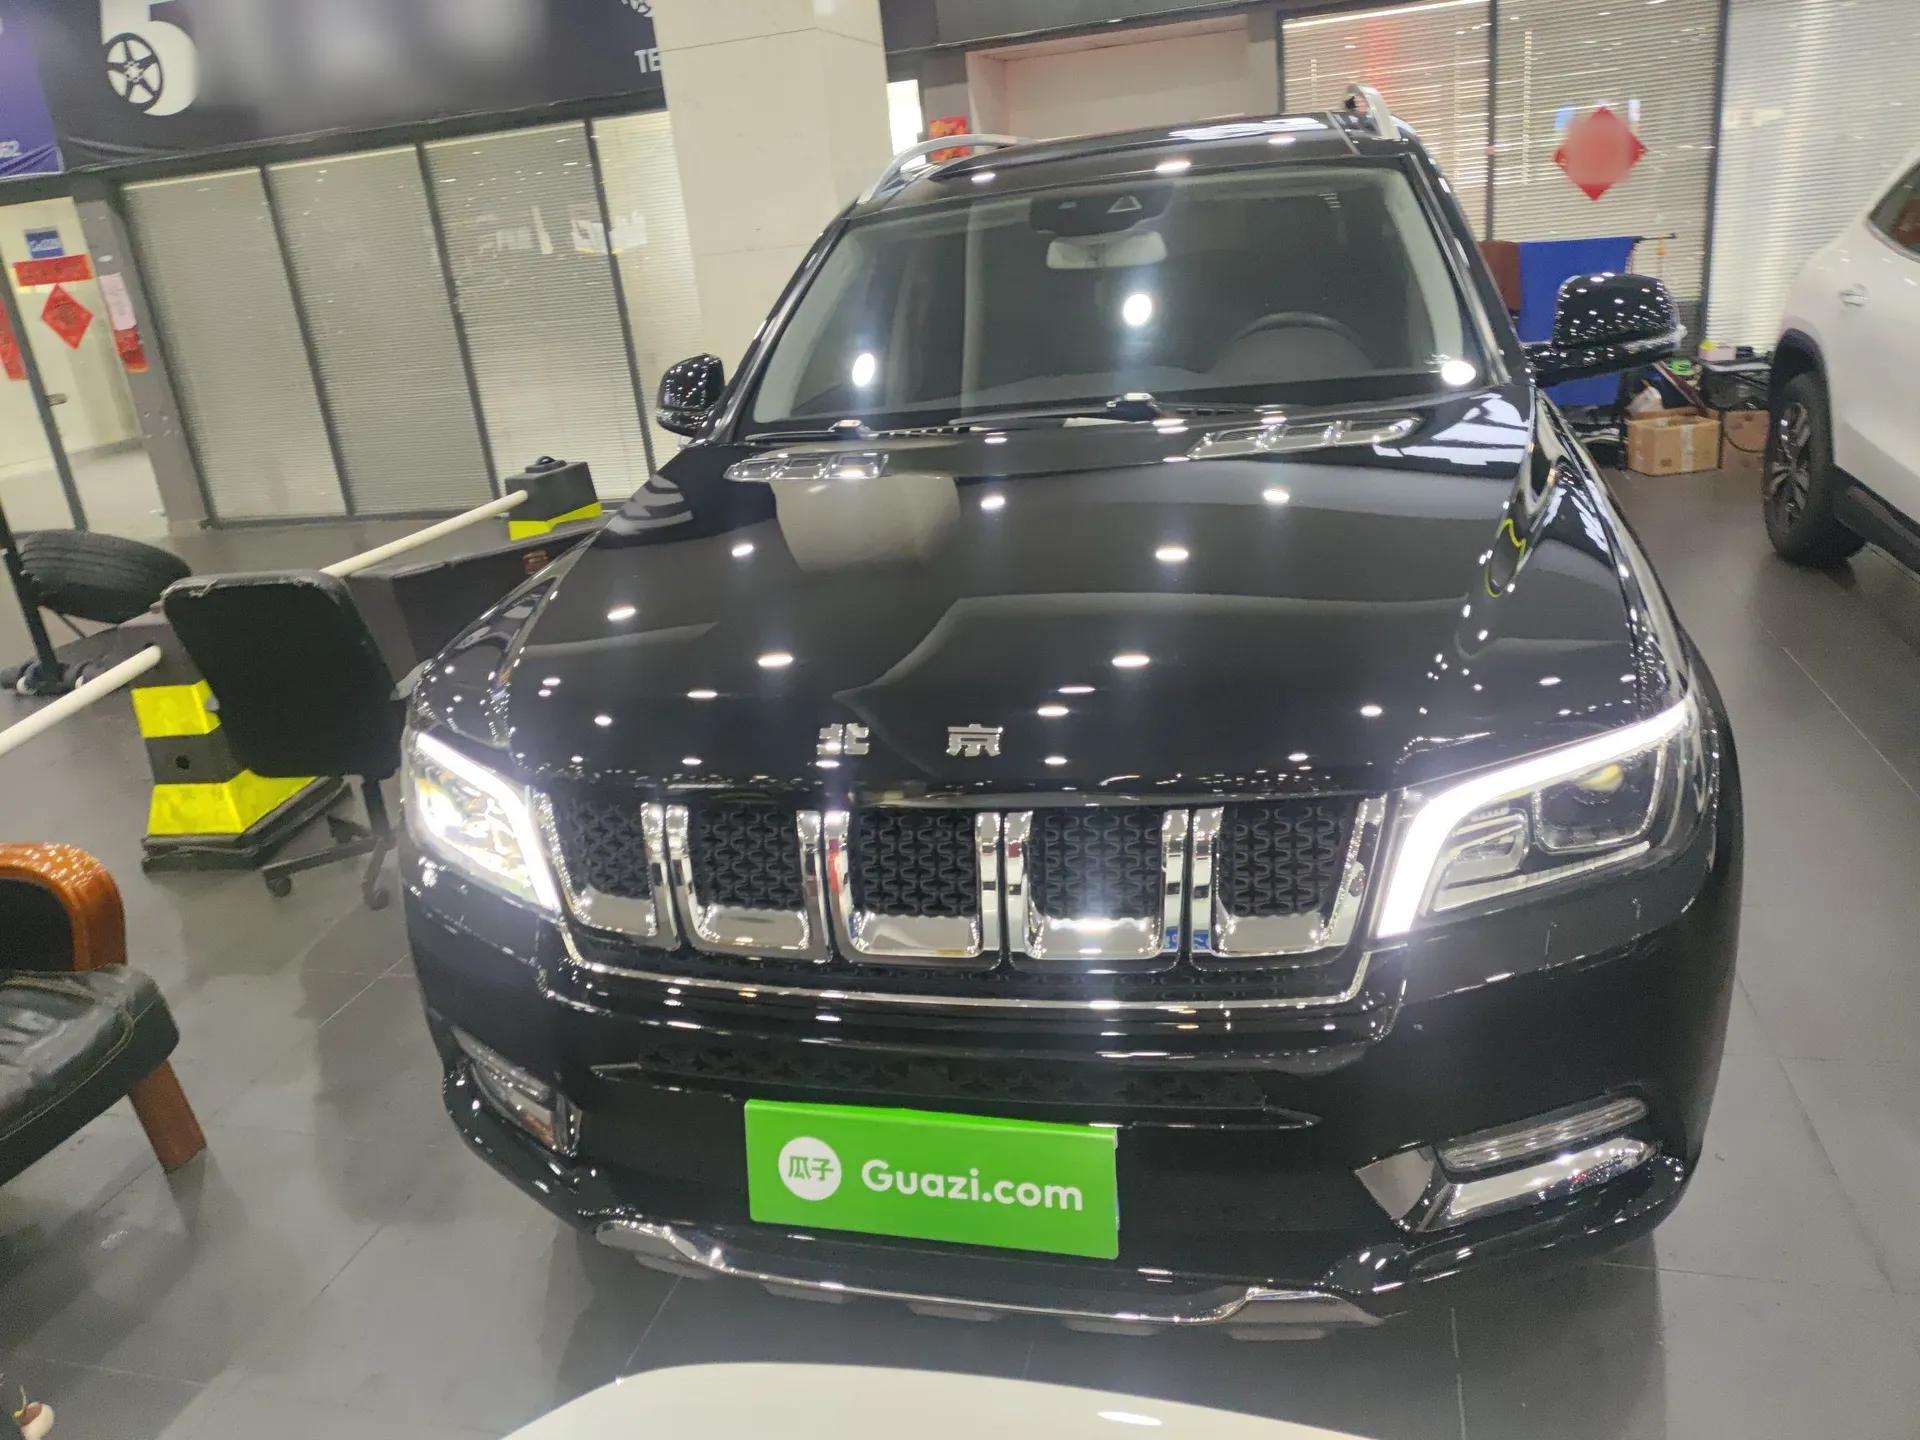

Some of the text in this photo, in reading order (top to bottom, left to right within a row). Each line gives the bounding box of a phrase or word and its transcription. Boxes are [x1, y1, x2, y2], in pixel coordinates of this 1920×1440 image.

[816, 723, 1003, 757] 北京
[788, 1155, 834, 1182] 瓜子
[861, 1159, 1084, 1211] Guazi.com
